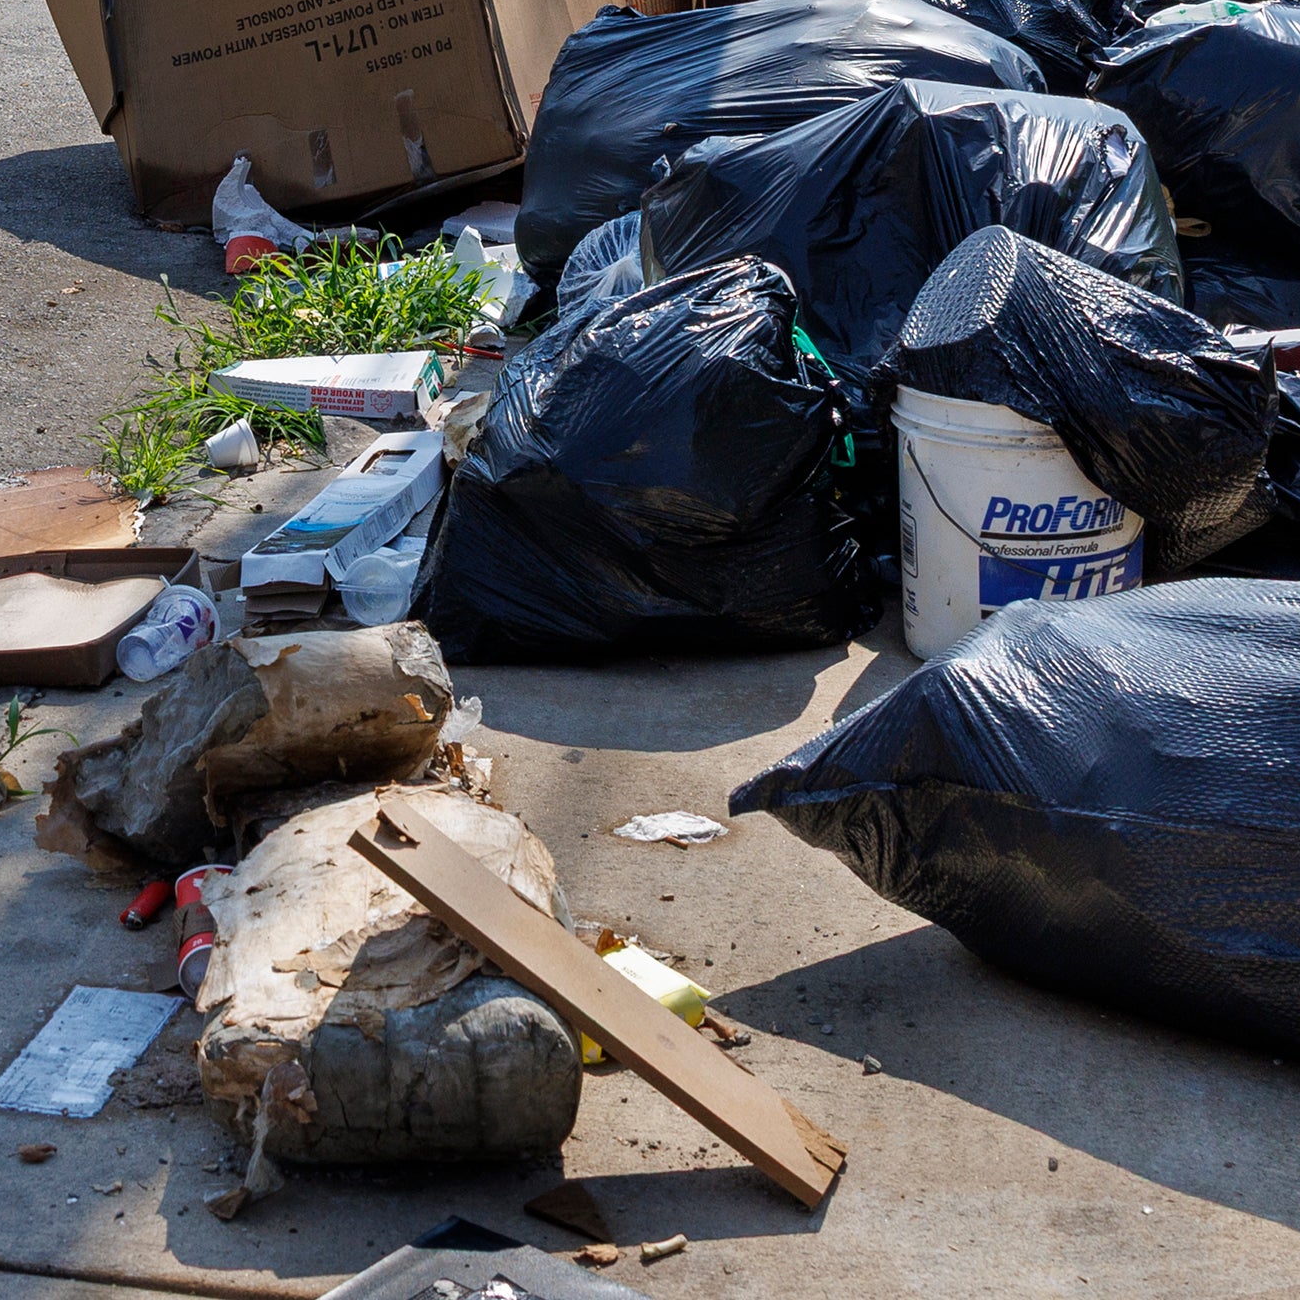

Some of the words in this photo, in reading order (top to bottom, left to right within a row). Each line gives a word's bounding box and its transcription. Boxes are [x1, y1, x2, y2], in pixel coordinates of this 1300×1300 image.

[235, 3, 294, 31] CONSOLE
[326, 0, 374, 26] POWER
[411, 3, 445, 22] ITEM
[260, 14, 324, 47] LOVESEAT
[225, 35, 258, 57] WITH
[304, 23, 379, 62] U71-L
[171, 43, 223, 67] POWER
[310, 387, 328, 396] CAR
[330, 389, 353, 398] YOUR
[354, 391, 365, 399] IN
[1100, 523, 1124, 535] BRAND
[980, 541, 1053, 557] Professional
[1054, 541, 1099, 556] Formula
[1038, 554, 1127, 601] LITE
